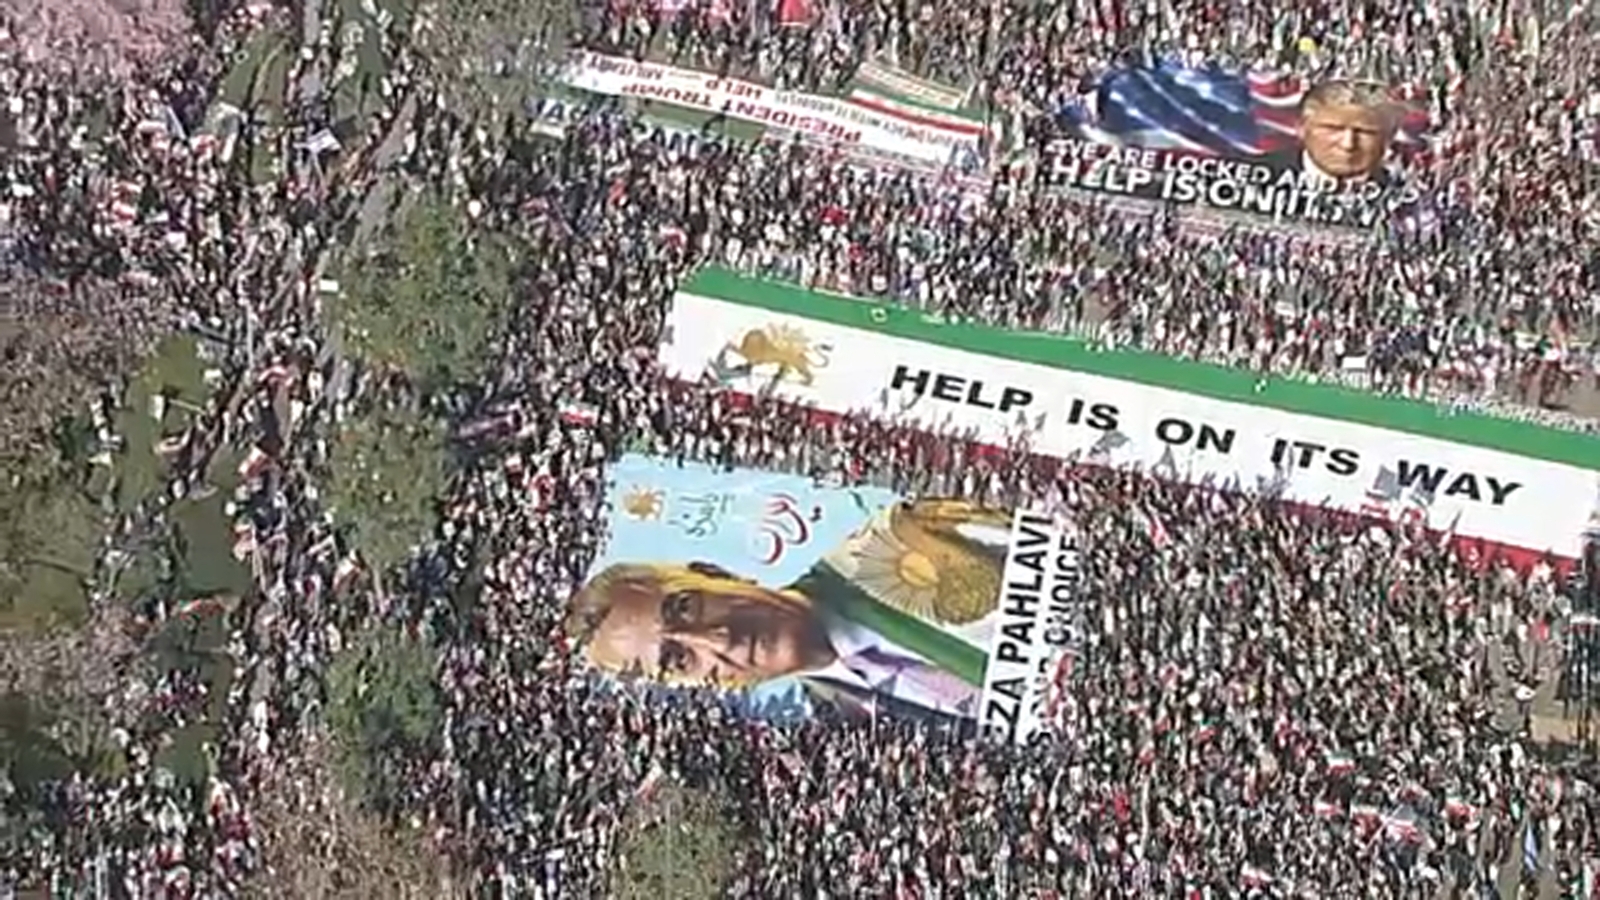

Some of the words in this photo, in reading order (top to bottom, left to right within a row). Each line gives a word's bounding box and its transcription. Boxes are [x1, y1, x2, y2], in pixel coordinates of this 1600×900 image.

[621, 83, 712, 108] TRUMP
[706, 78, 762, 99] HELP
[721, 99, 862, 142] PRESIDENT
[1050, 155, 1150, 193] HELP
[1162, 171, 1195, 200] IS
[1209, 178, 1274, 211] ON
[1105, 146, 1155, 168] ARE
[1163, 153, 1271, 184] LOCKED
[1275, 168, 1338, 193] AND
[891, 364, 1033, 413] HELP
[1066, 398, 1120, 432] IS
[1155, 417, 1236, 454] ON
[1270, 438, 1361, 476] ITS
[1398, 459, 1523, 505] WAY
[997, 515, 1053, 664] PAHLAVI
